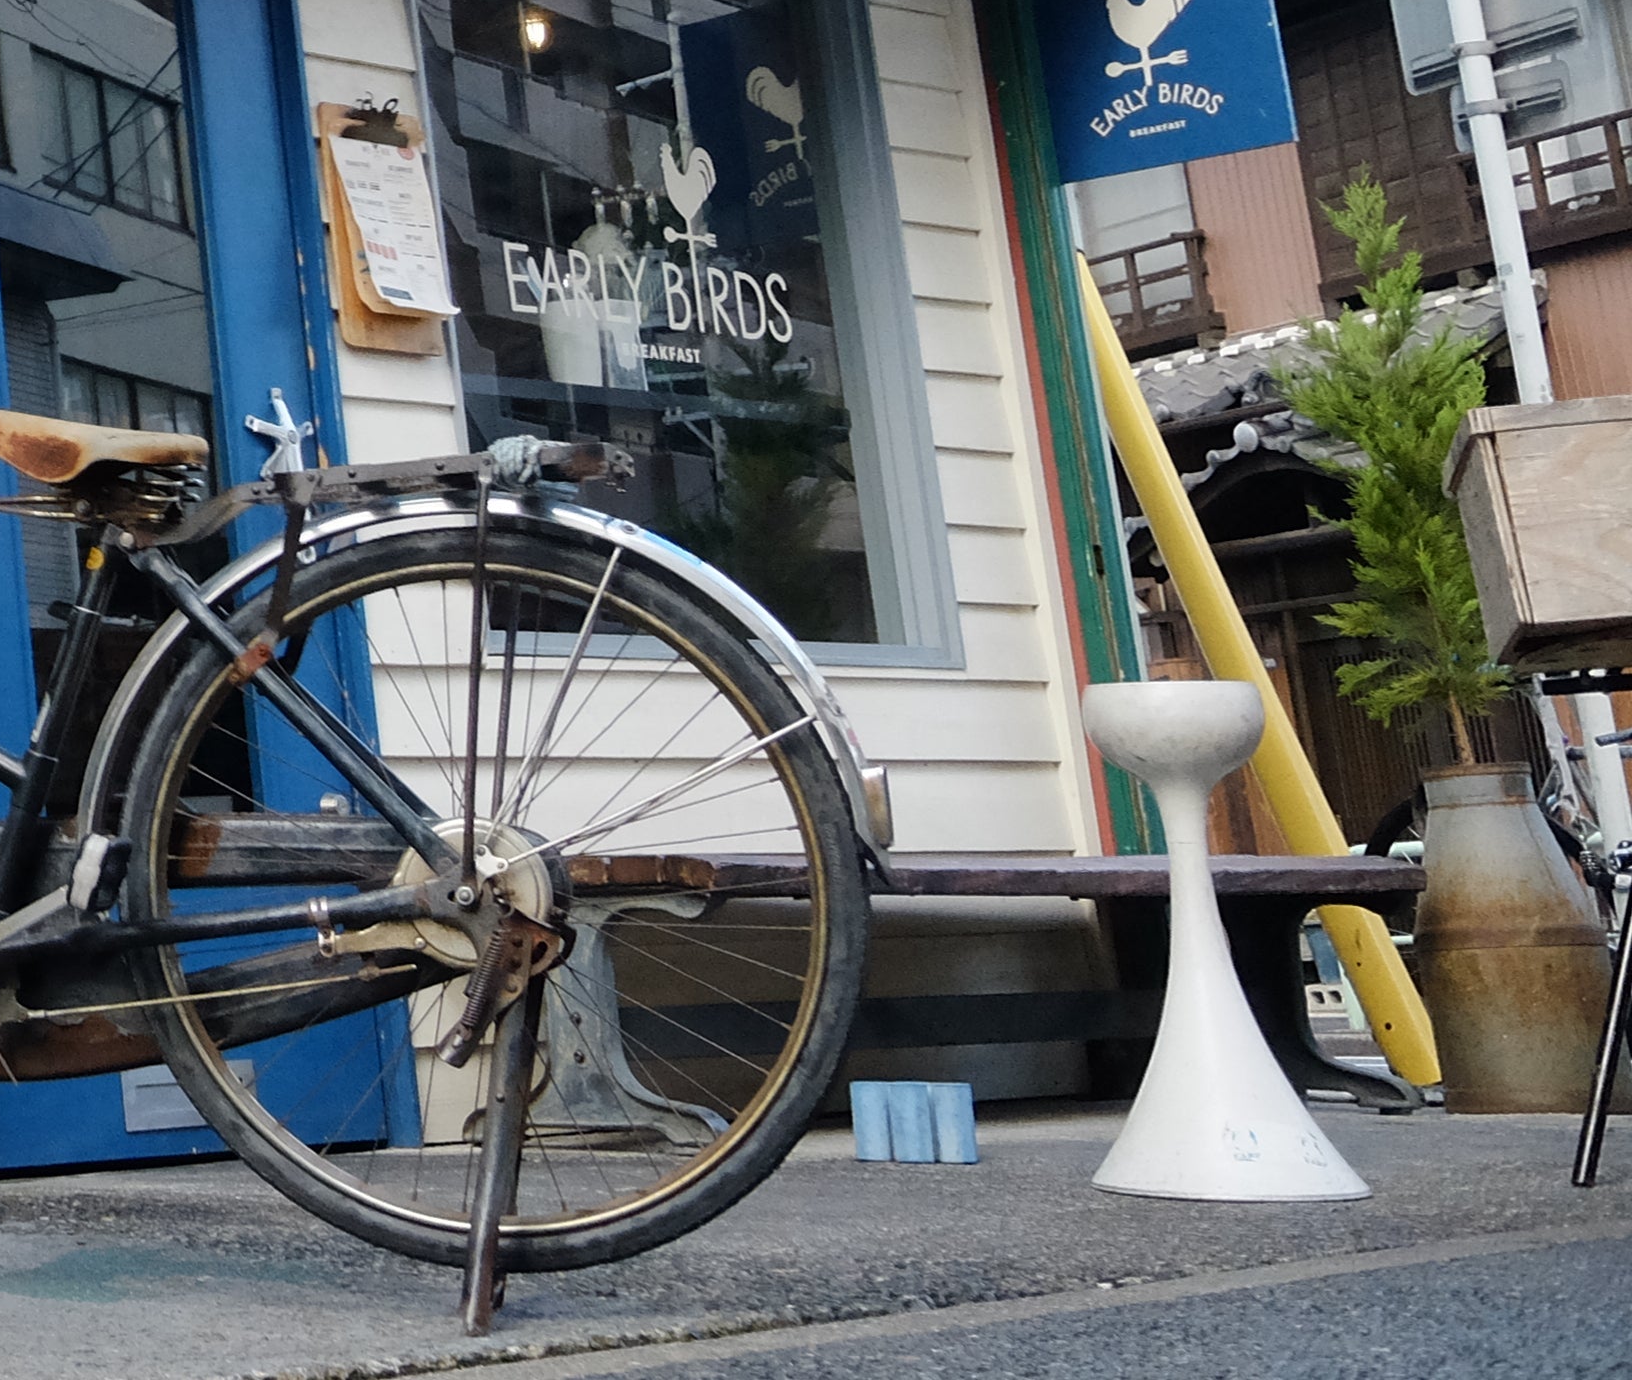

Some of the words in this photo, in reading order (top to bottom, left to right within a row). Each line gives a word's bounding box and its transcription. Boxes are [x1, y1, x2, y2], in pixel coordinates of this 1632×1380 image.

[1090, 84, 1150, 138] EARLY
[1158, 82, 1225, 115] BIRDS
[502, 240, 648, 326] EARLY
[662, 260, 793, 344] BIRDS
